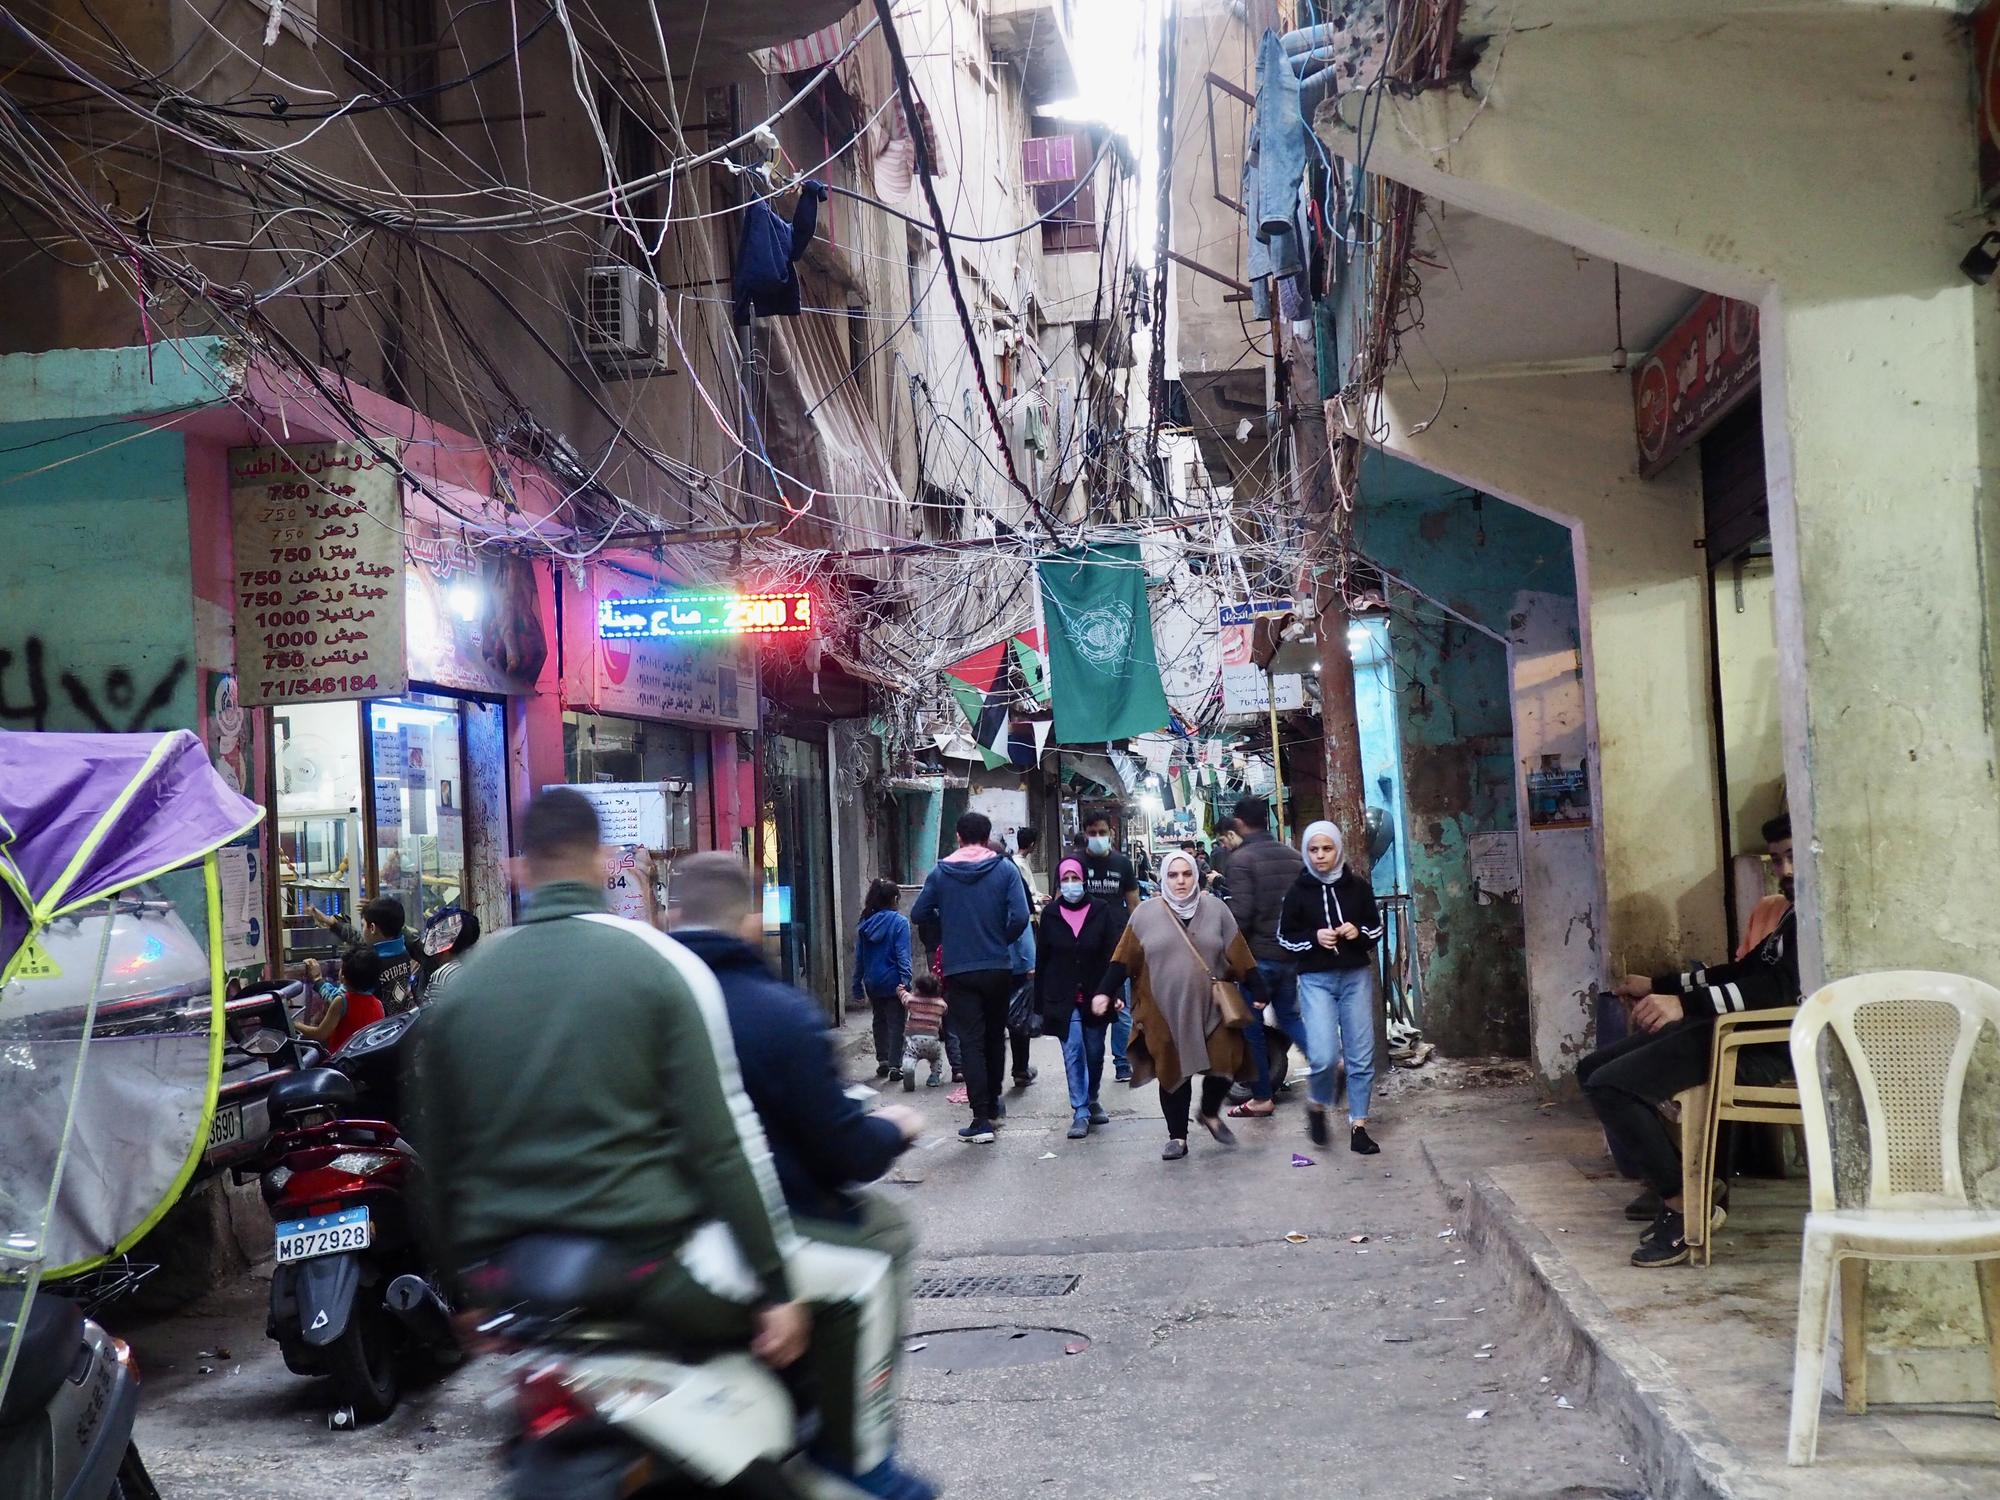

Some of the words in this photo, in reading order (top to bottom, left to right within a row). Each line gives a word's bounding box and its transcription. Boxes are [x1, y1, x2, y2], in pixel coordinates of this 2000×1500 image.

[268, 483, 310, 501] 750
[316, 481, 356, 497] جبنة
[306, 500, 368, 520] شوكولا
[314, 522, 360, 541] زعتر
[270, 546, 312, 564] 750
[318, 545, 357, 562] بيتزا
[240, 570, 282, 587] 750
[288, 567, 351, 585] وزيتون
[356, 562, 395, 577] جبنة
[240, 590, 283, 608] 750
[288, 588, 344, 606] وزعتر
[348, 584, 389, 600] جبنة
[255, 609, 311, 628] 1000
[263, 630, 318, 649] 1000
[323, 627, 369, 645] حبش
[263, 651, 305, 670] 750
[260, 674, 378, 698] 71/546184
[279, 1226, 366, 1259] M872928
